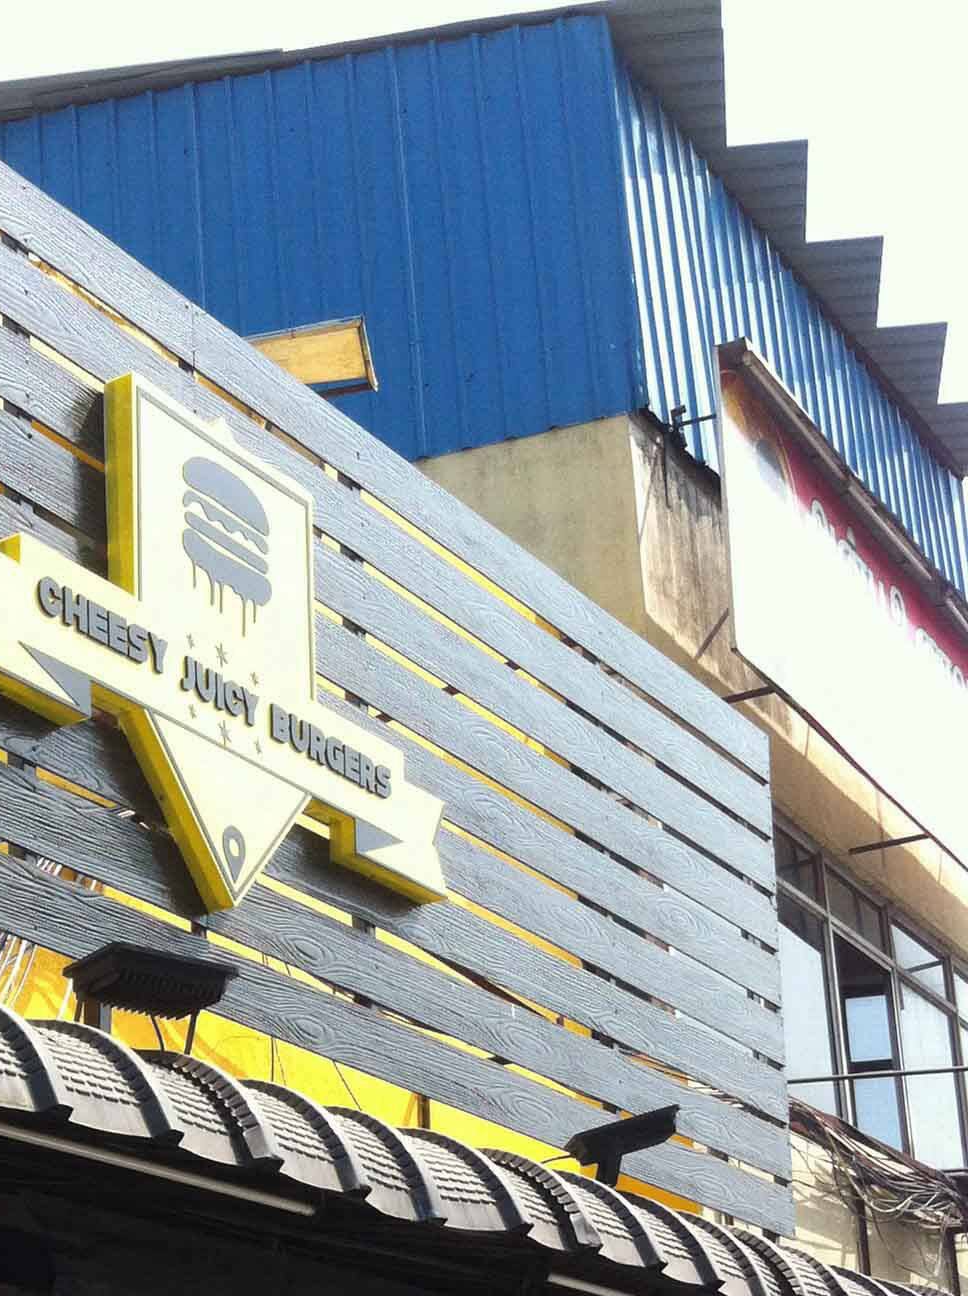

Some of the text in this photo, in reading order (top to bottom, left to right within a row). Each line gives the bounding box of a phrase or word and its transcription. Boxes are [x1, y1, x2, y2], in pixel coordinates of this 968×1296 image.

[37, 576, 392, 799] CHEESY JUICY BURGERS
